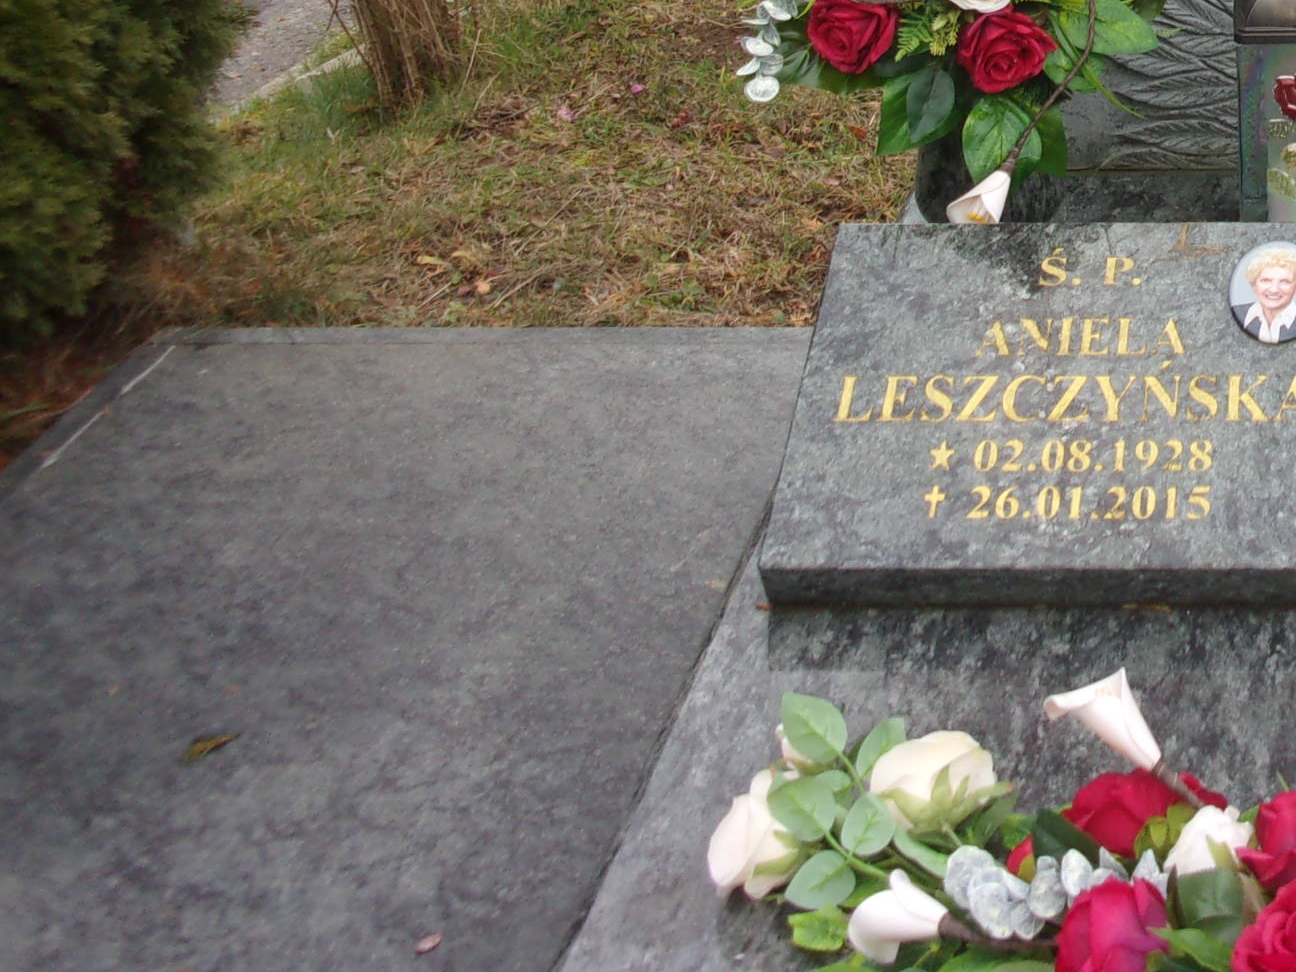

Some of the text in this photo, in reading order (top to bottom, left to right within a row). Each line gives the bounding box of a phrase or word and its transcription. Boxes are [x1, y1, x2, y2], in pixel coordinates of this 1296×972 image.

[1038, 248, 1141, 287] Ś. P.
[975, 318, 1185, 356] ANIELA
[973, 439, 1213, 472] 02.08.1928
[965, 485, 1212, 520] 26.01.2015
